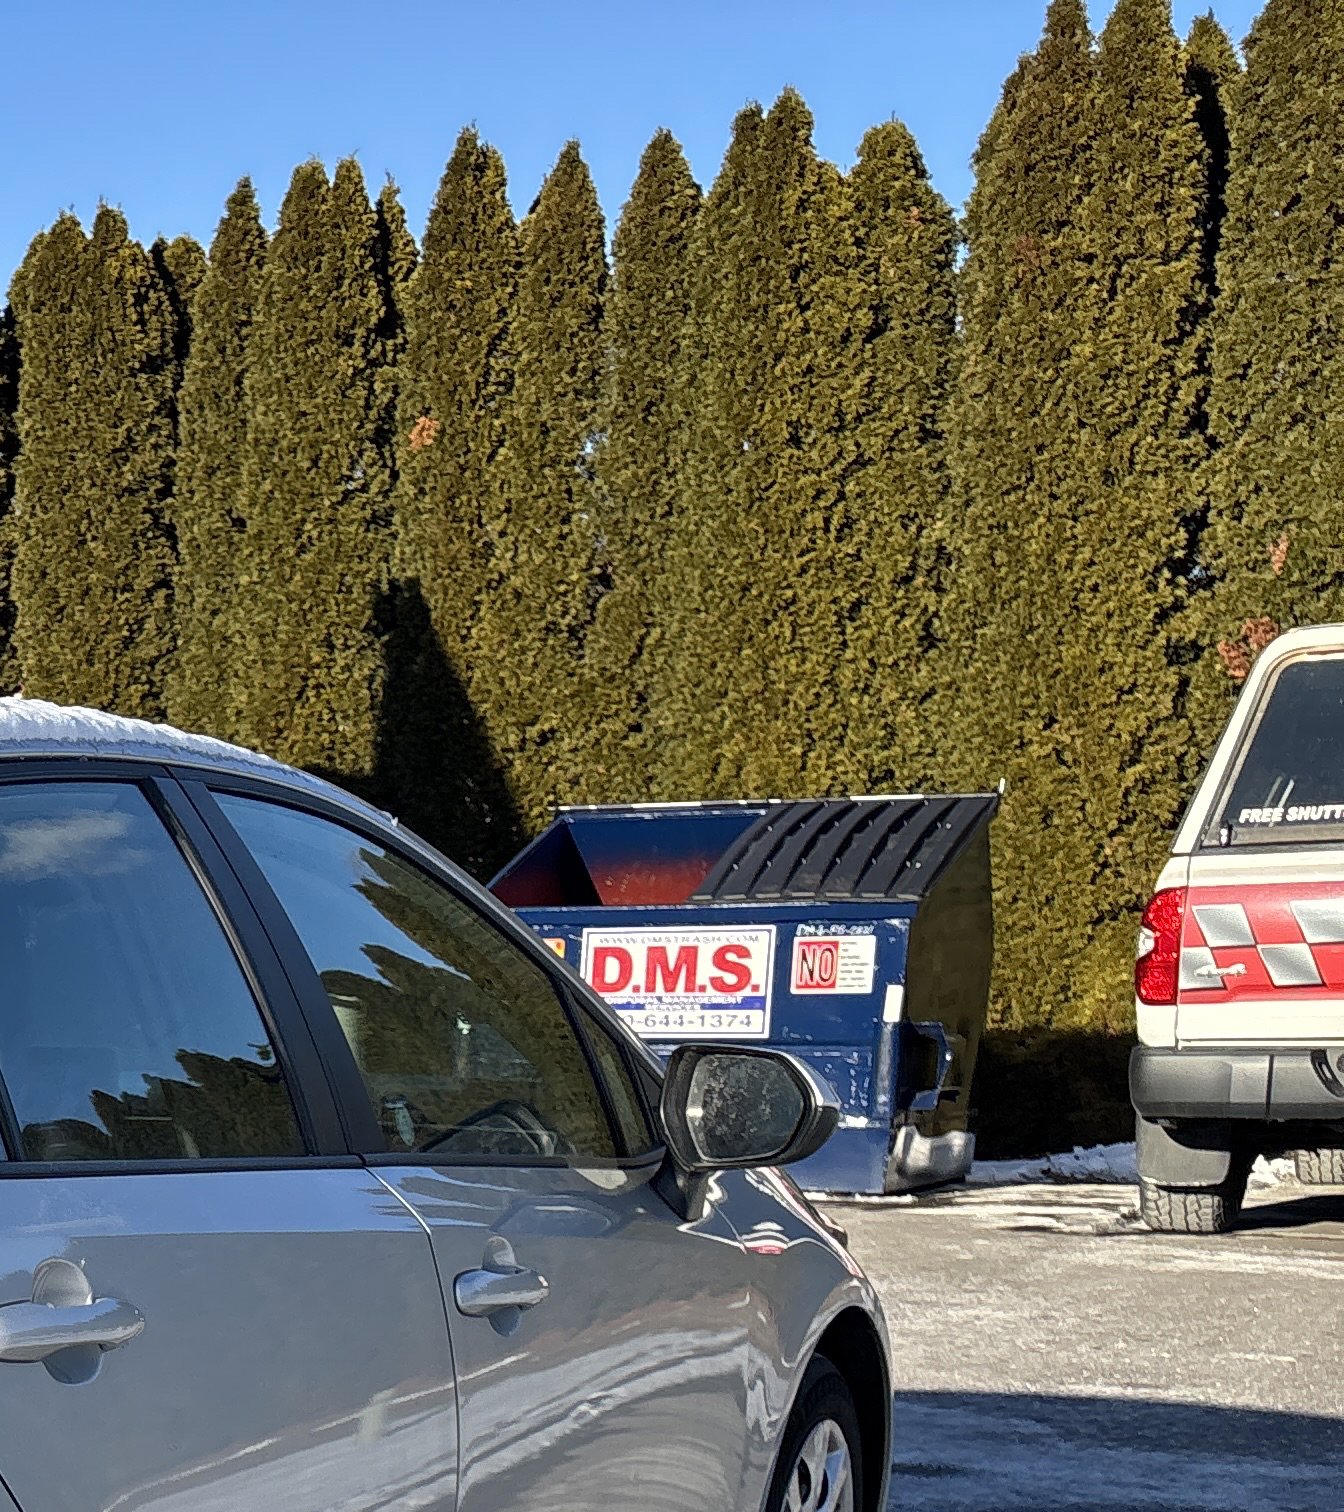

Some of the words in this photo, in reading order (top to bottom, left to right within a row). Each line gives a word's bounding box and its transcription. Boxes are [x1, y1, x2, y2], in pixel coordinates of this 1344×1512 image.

[1238, 807, 1285, 823] FREE
[1285, 804, 1344, 822] SHUTT
[591, 943, 761, 993] D.M.S.
[797, 944, 837, 987] NO
[622, 1013, 752, 1029] 0-644-1374
